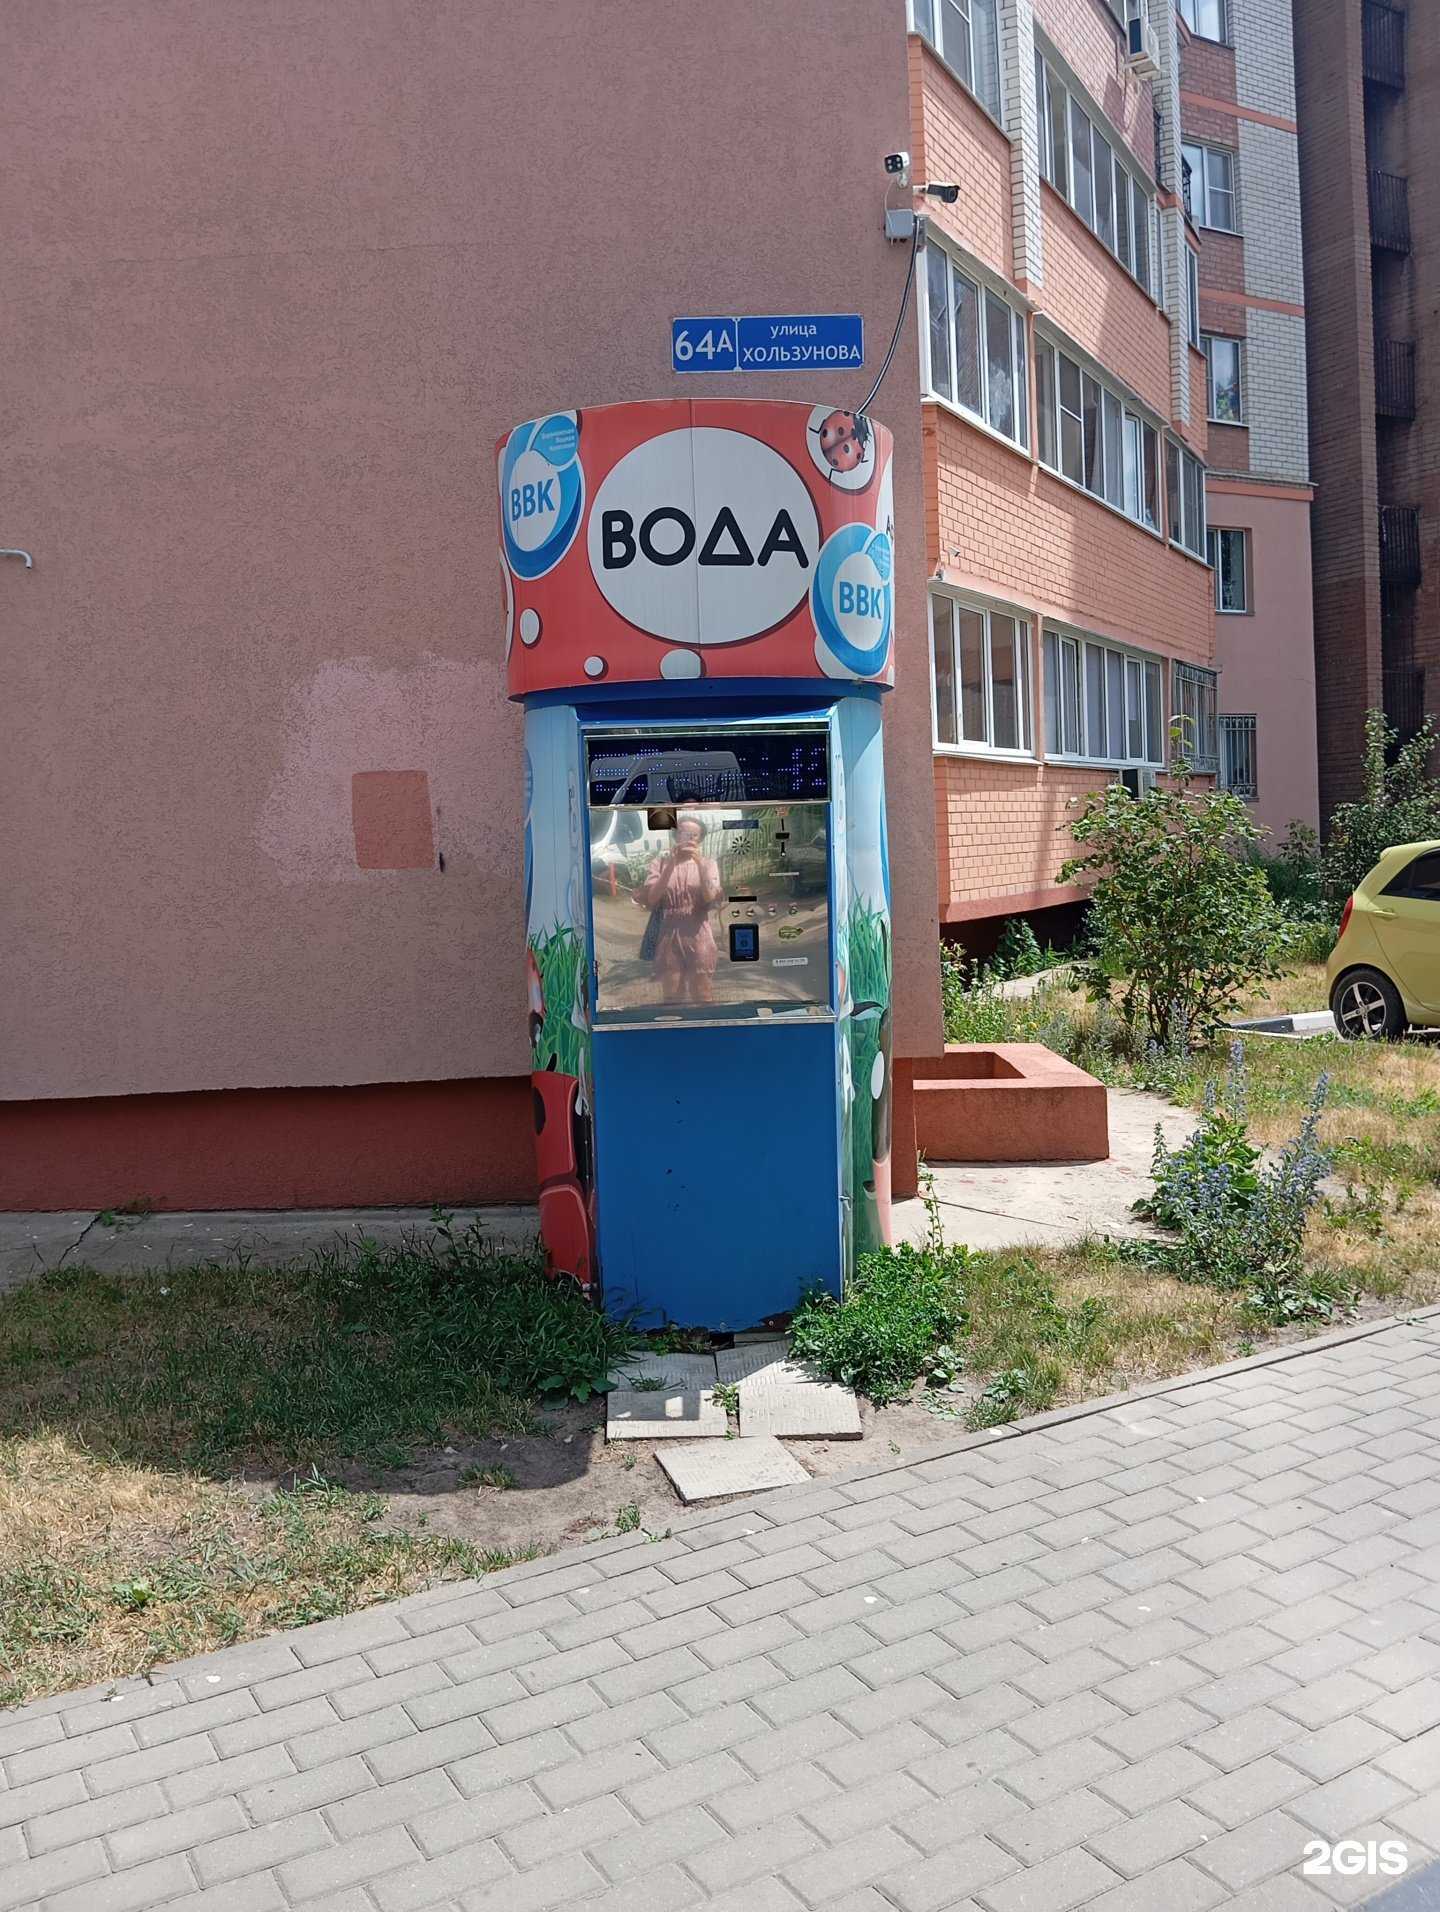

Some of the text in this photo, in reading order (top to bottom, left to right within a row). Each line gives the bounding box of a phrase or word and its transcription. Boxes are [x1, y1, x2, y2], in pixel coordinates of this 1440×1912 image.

[675, 330, 733, 361] 64А
[770, 323, 817, 338] улица
[743, 344, 862, 363] ХОЛЬЗУНОВА
[512, 478, 555, 521] ВВК
[601, 506, 810, 570] ВОДА
[838, 580, 883, 621] ВВК
